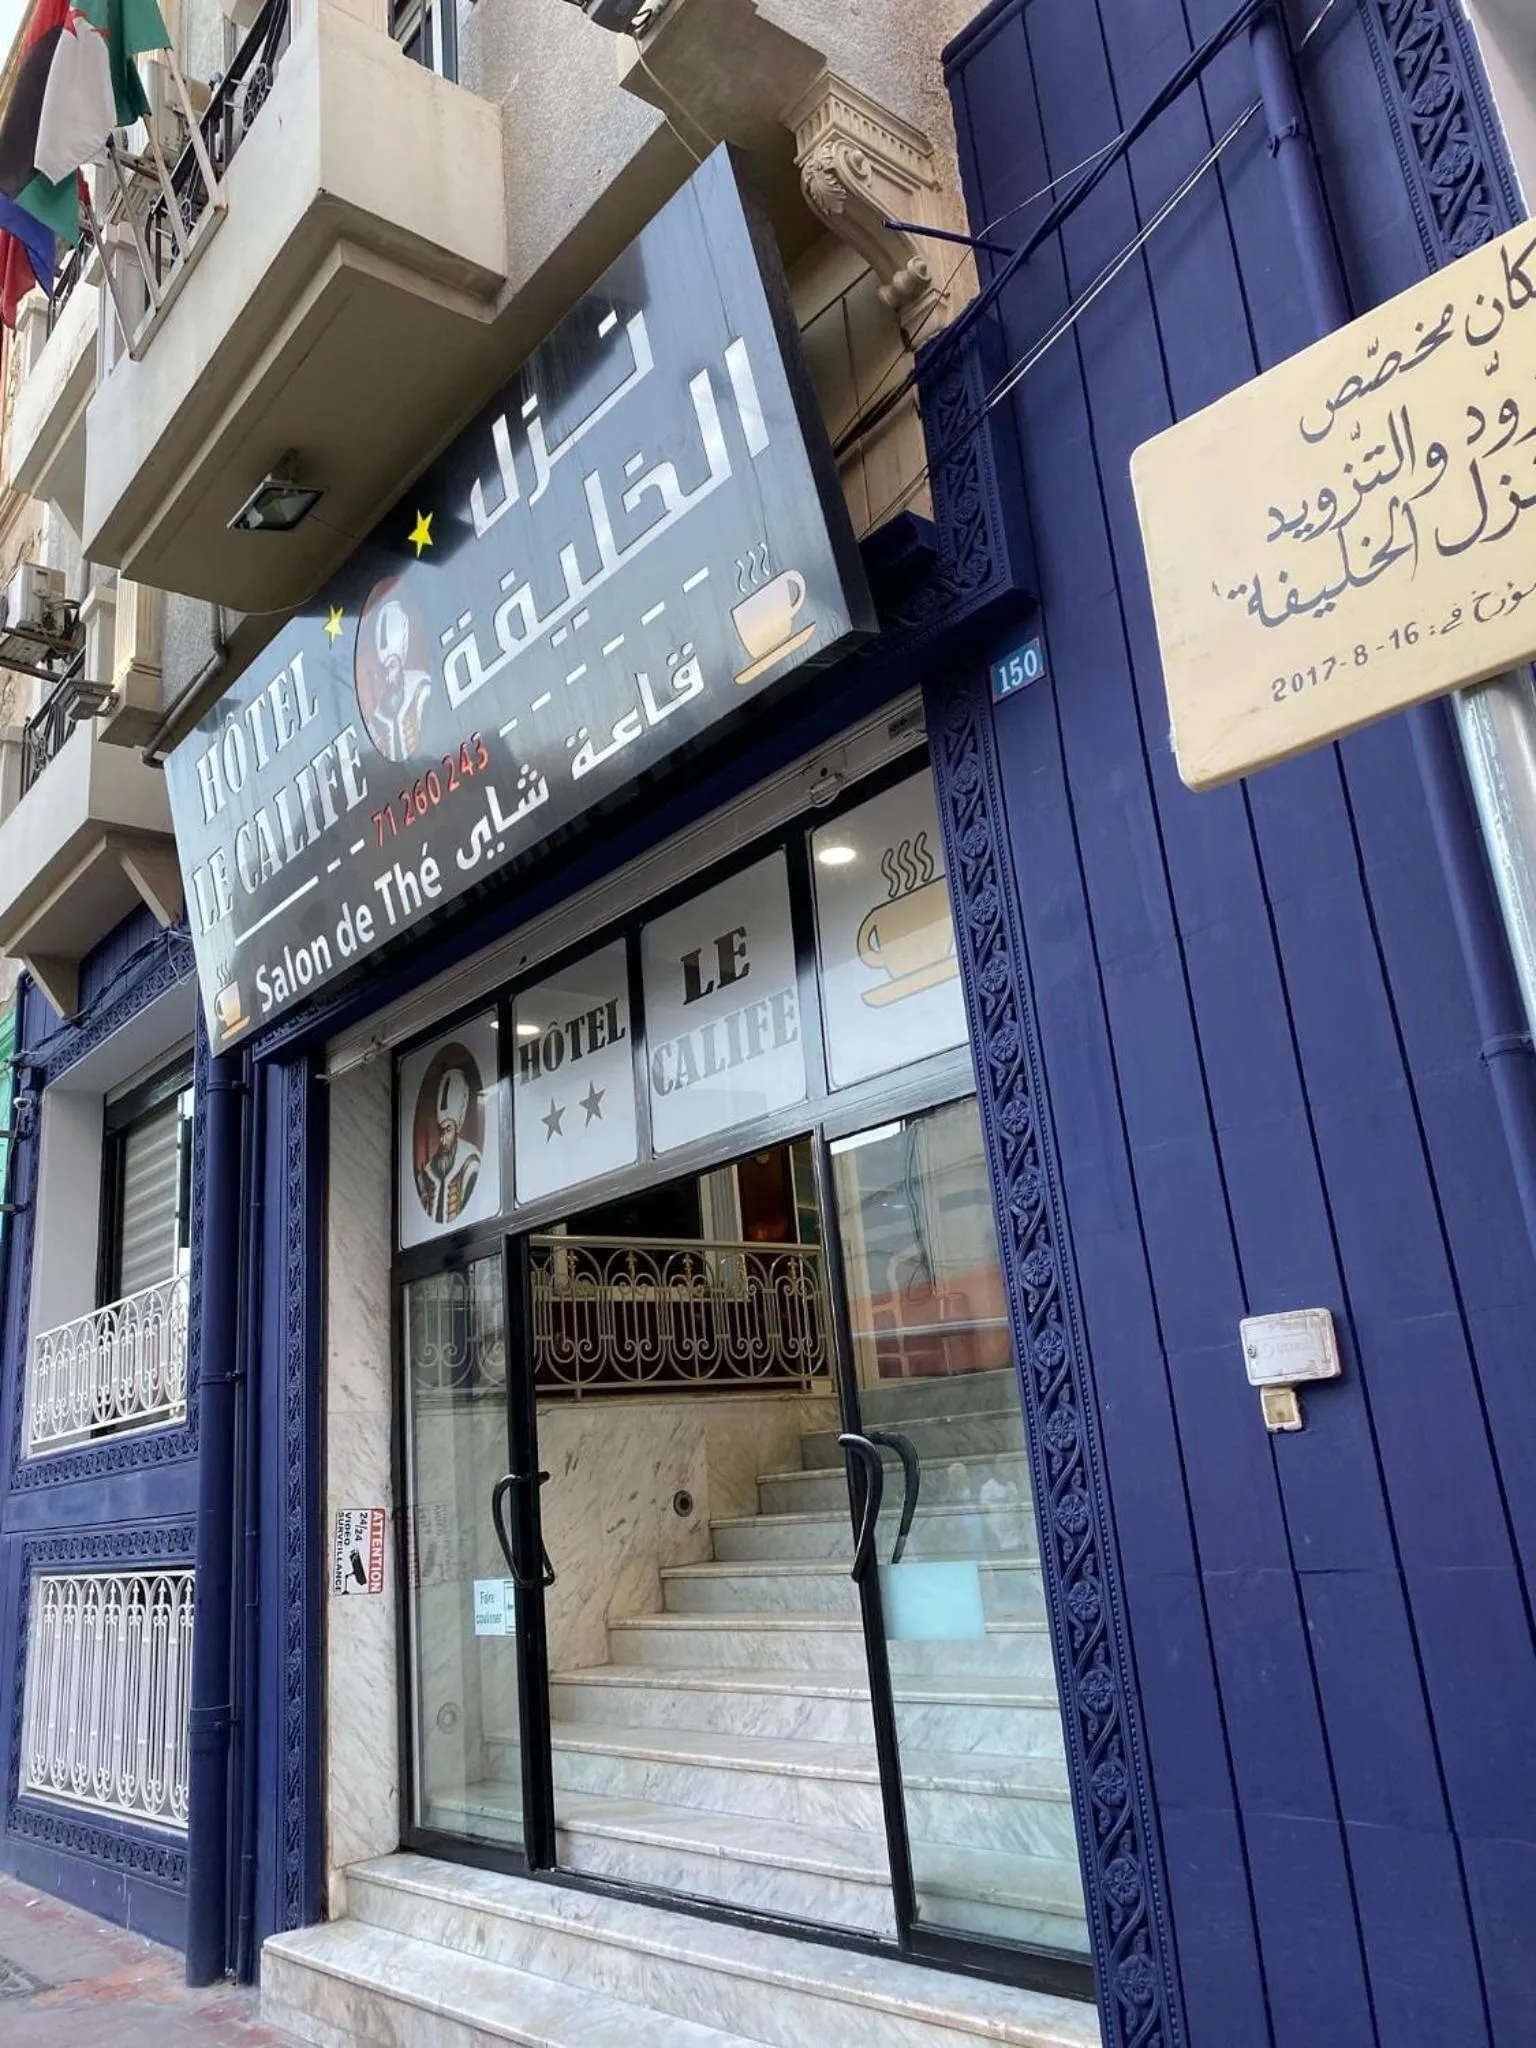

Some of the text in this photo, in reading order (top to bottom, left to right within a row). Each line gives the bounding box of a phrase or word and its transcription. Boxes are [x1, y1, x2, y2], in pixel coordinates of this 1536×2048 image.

[1465, 237, 1536, 346] كان
[469, 310, 655, 540] نزل
[440, 336, 771, 711] الخليفة
[1226, 495, 1418, 628] الخليفة
[999, 649, 1038, 693] 150
[196, 650, 319, 825] HÔTEL
[371, 731, 490, 848] 71 260 243
[455, 642, 705, 870] قاعة شاي
[192, 722, 368, 936] LE CALIFE
[255, 841, 443, 1013] Salon de Thé
[679, 925, 751, 1006] LE
[517, 996, 626, 1087] HÔTEL
[651, 988, 799, 1097] CALIFE
[335, 1512, 345, 1590] SURVEILLANCE
[354, 1512, 368, 1541] 24/24
[371, 1511, 384, 1592] ATTENTION
